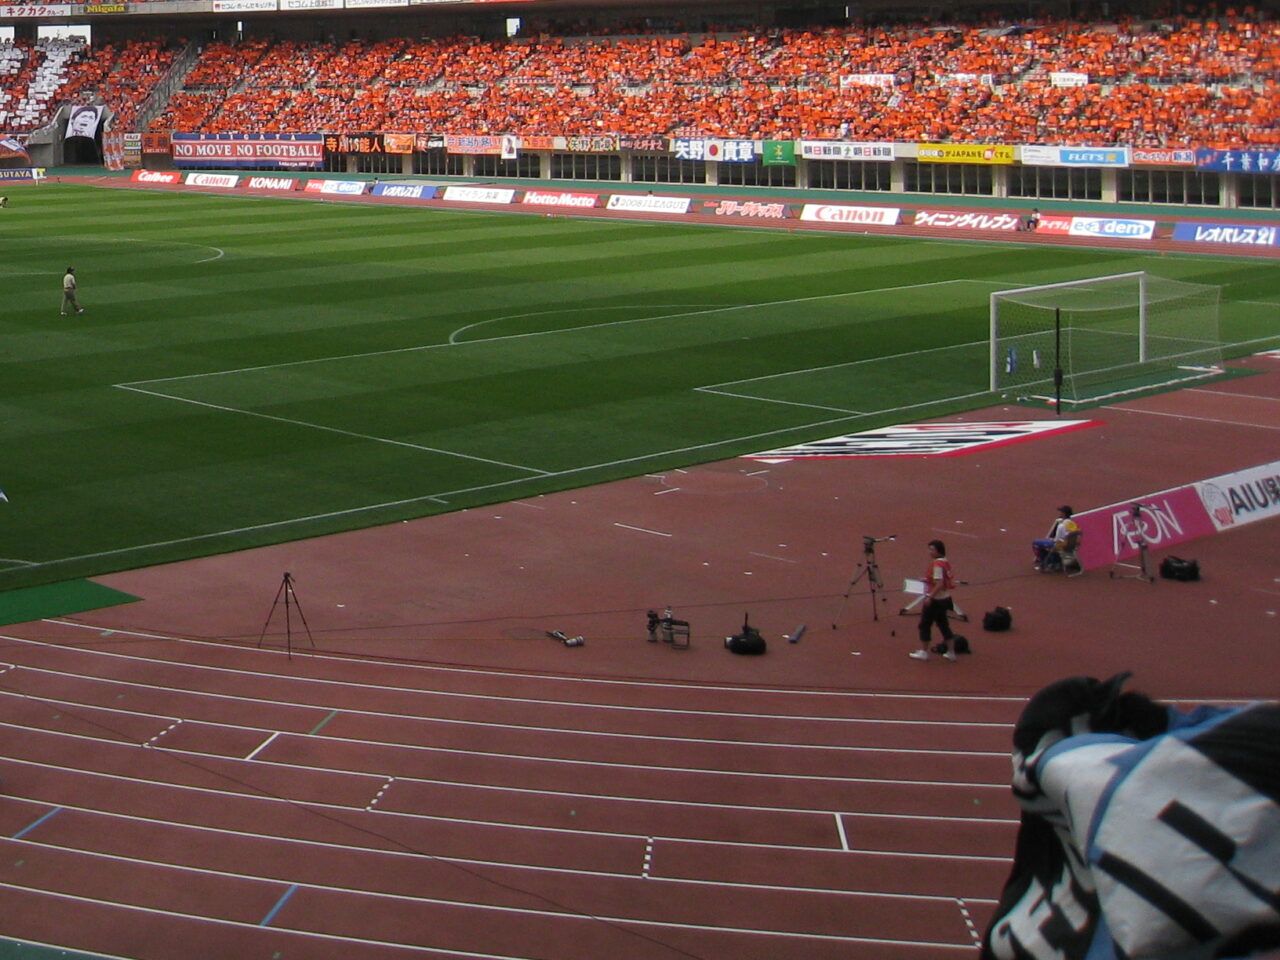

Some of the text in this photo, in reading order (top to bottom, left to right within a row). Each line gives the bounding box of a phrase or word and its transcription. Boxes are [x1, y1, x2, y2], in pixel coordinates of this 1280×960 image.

[175, 144, 193, 157] NO
[236, 144, 253, 157] NO
[256, 144, 321, 157] FOOTBALL
[138, 170, 173, 183] Calbee
[193, 174, 231, 185] Canon
[248, 176, 293, 190] KONAMI
[814, 205, 885, 223] Canon
[1194, 225, 1276, 245] レオパレス21
